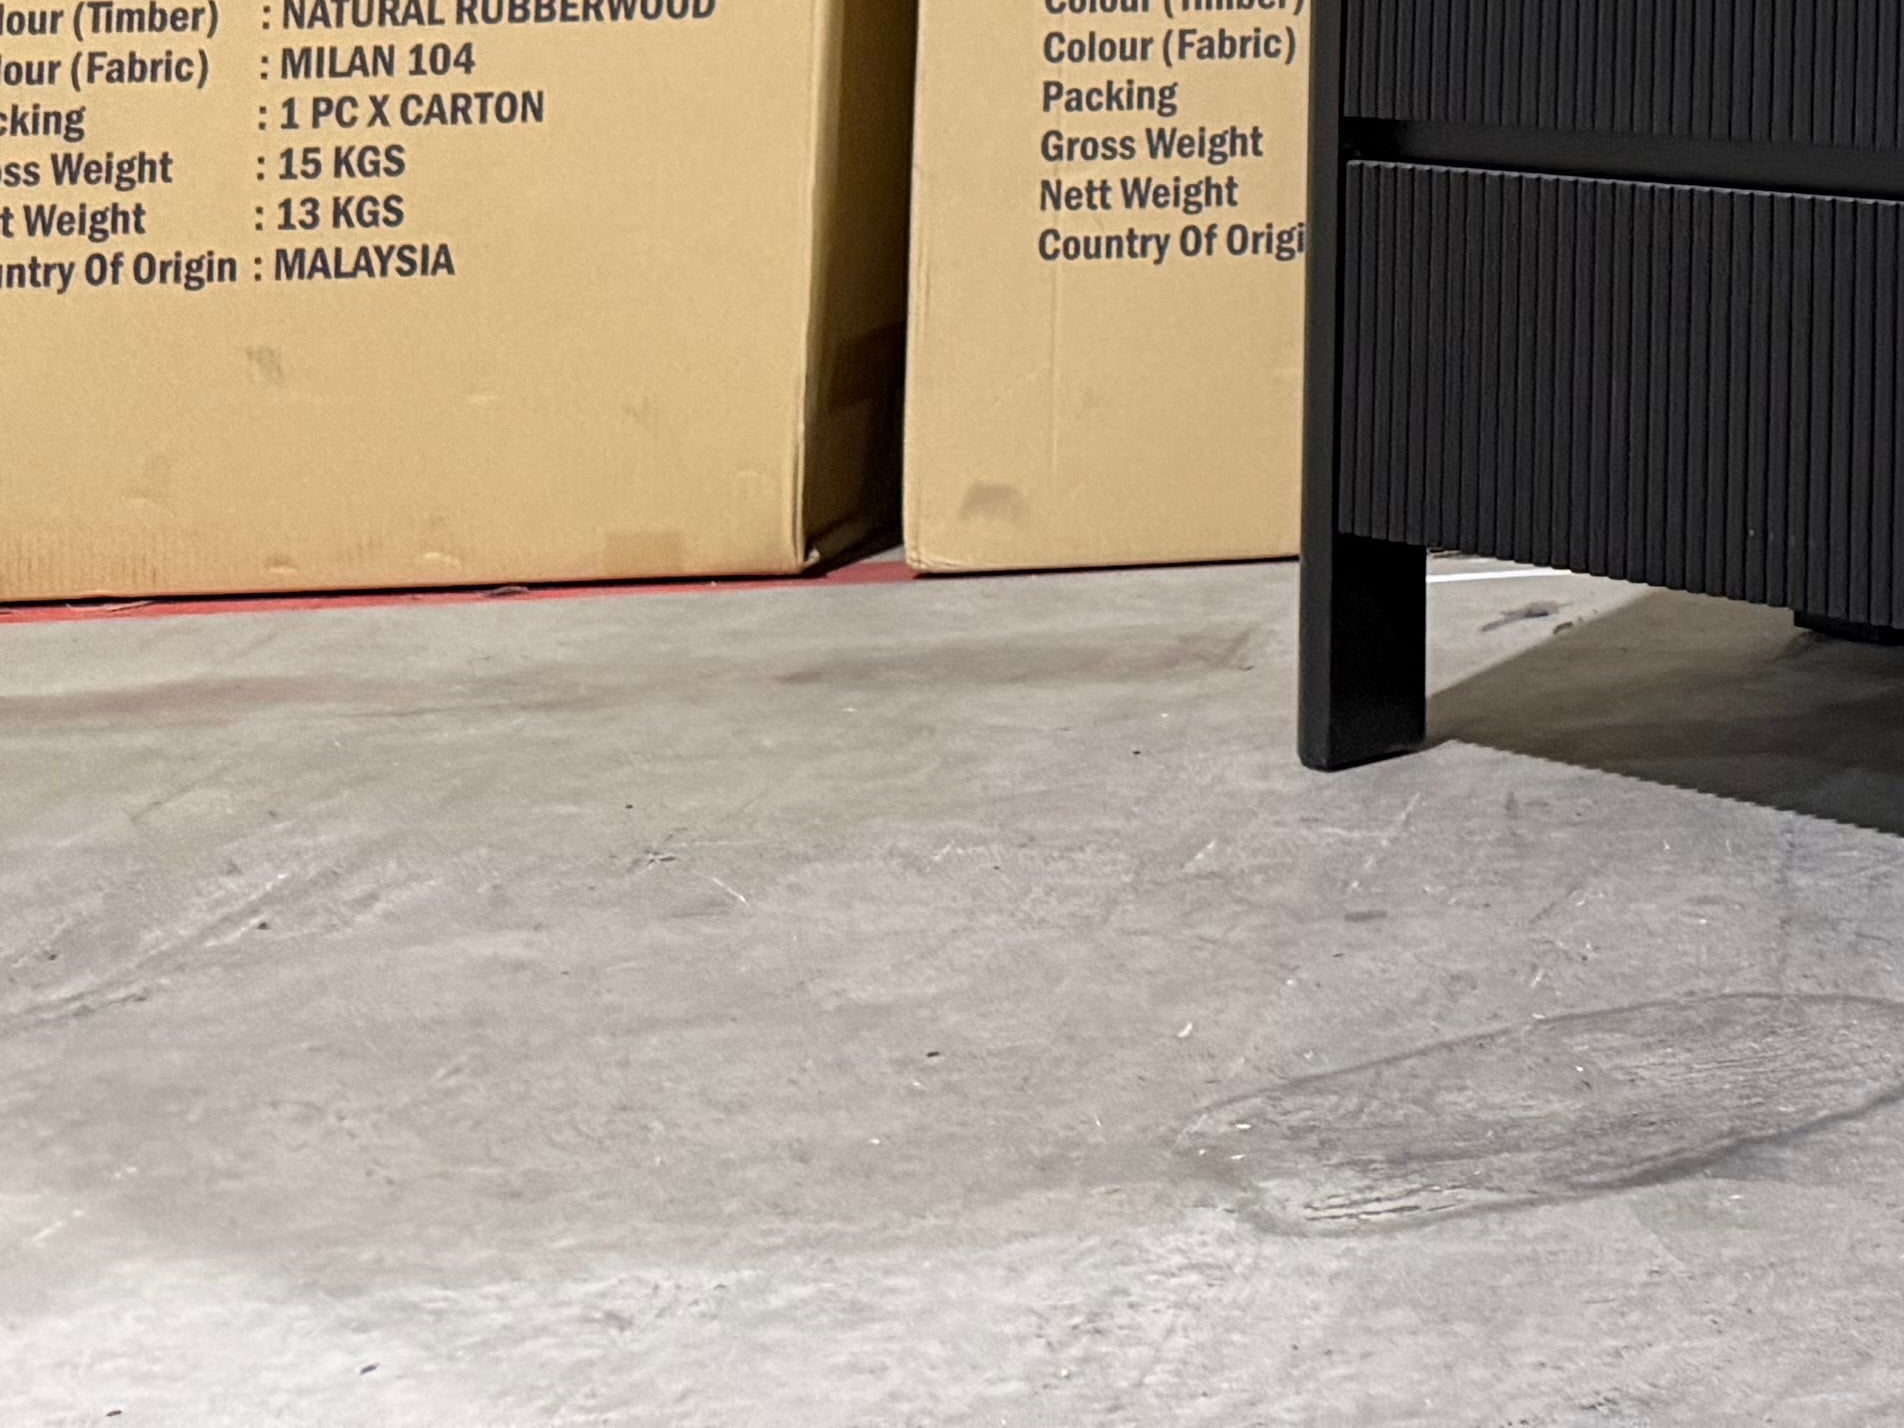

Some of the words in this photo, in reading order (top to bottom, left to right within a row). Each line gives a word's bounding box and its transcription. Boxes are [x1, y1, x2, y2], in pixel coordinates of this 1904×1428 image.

[280, 97, 300, 130] 1
[311, 95, 359, 129] PC
[366, 94, 391, 128] X
[400, 90, 544, 127] CARTON
[1043, 78, 1178, 118] Packing
[1041, 129, 1136, 162] Gross
[1145, 125, 1263, 166] Weight
[1038, 227, 1171, 266] Country
[1179, 223, 1218, 257] Of
[1227, 222, 1304, 261] Origi
[84, 251, 124, 287] Of
[133, 250, 237, 291] Origin
[274, 243, 455, 281] MALAYSIA
